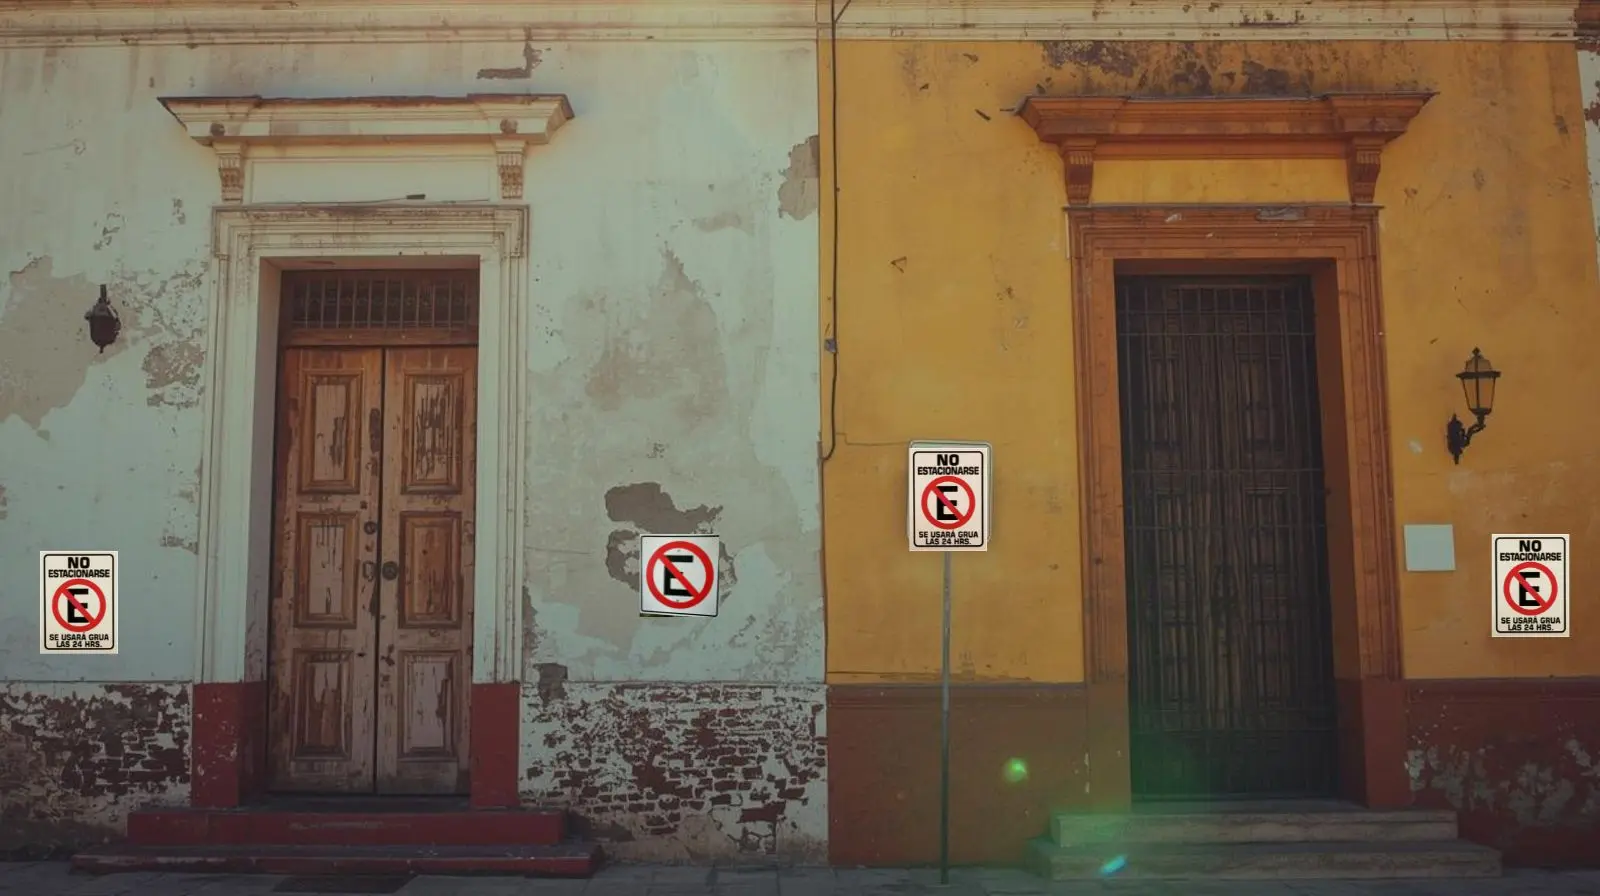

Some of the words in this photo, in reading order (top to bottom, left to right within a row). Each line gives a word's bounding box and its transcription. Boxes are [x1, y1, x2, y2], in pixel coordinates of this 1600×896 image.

[937, 454, 960, 466] NO
[917, 466, 980, 475] ESTACIONARSE
[1520, 540, 1542, 552] NO
[1500, 552, 1562, 561] ESTACIONARSE
[68, 556, 90, 568] NO
[48, 569, 110, 578] ESTACIONARSE
